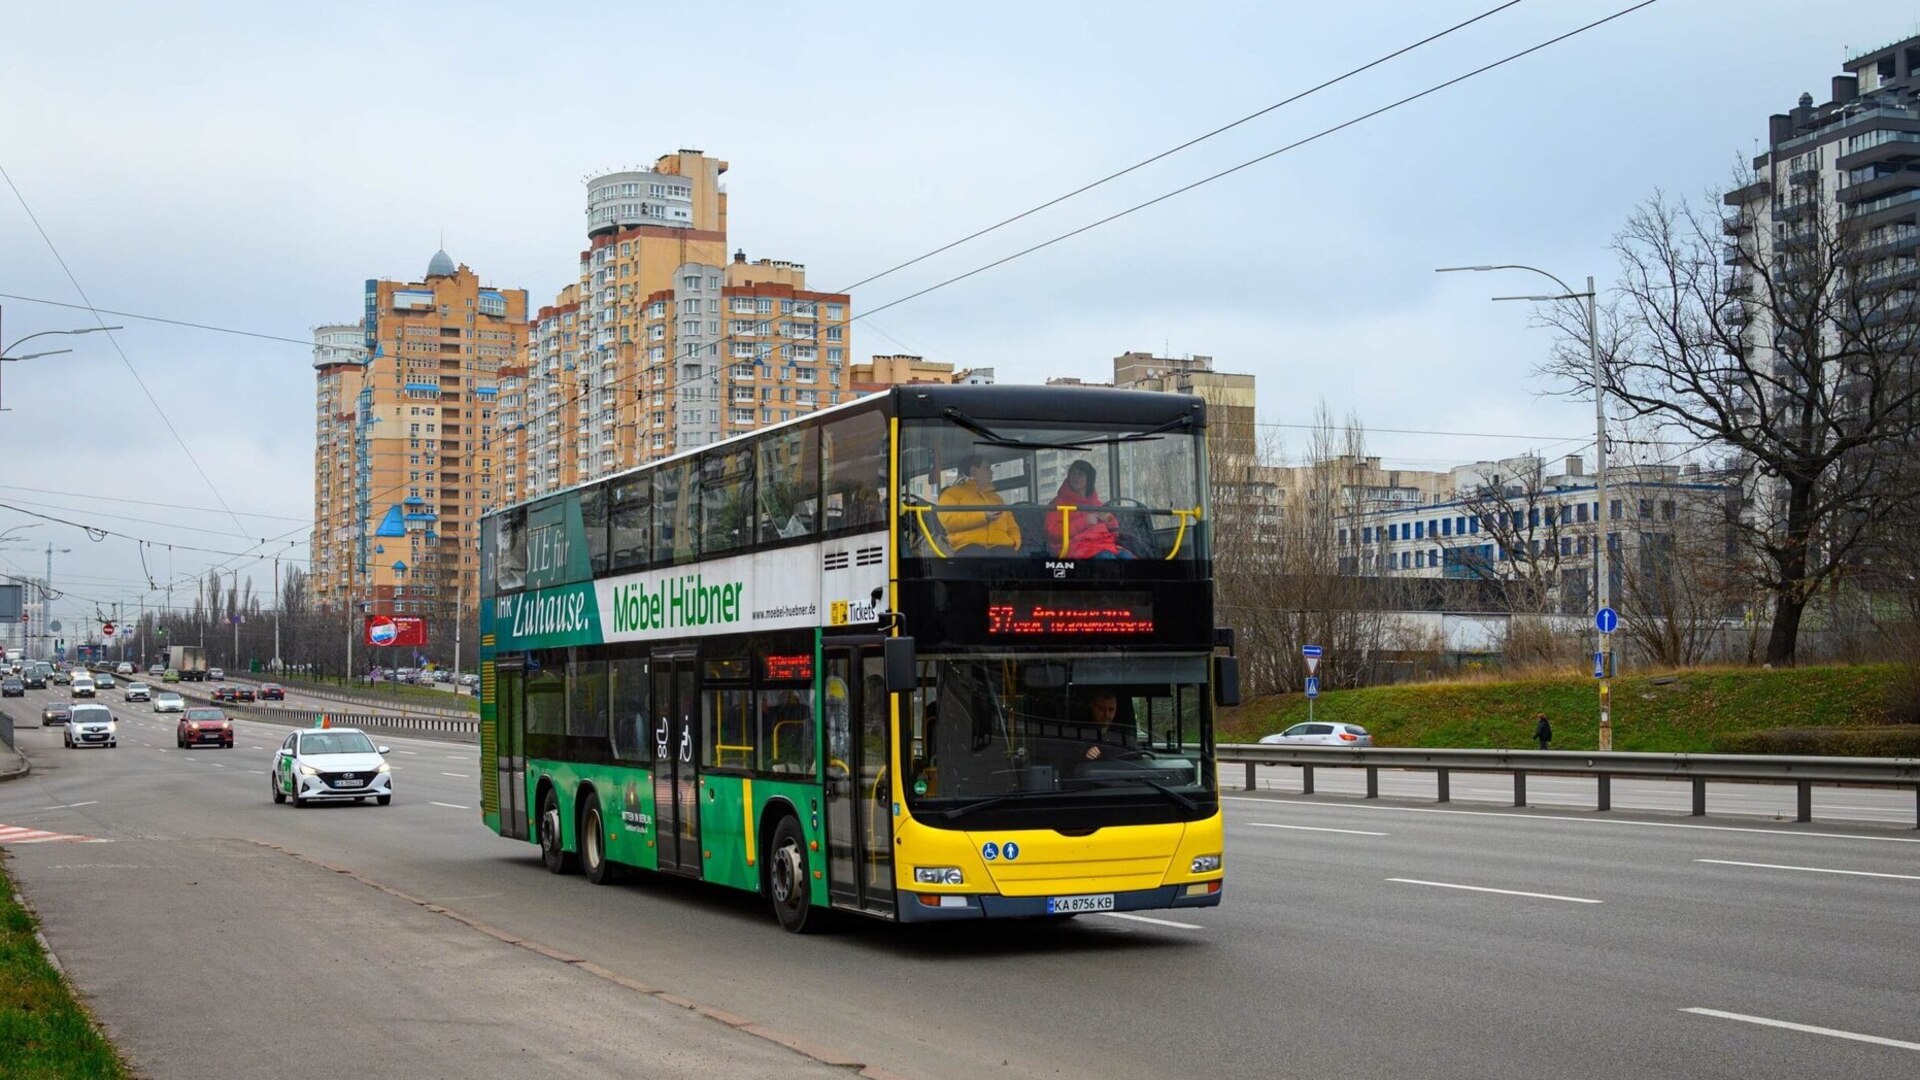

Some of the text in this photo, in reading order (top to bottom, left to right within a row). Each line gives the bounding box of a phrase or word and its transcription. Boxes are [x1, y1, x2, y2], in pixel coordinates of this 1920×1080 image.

[550, 529, 570, 581] für
[1045, 561, 1075, 569] MAN
[512, 578, 589, 637] Zuhause.
[613, 573, 743, 633] Möbel Hübner
[752, 602, 816, 620] www.moebel-huebner.de
[849, 602, 876, 621] Tickets
[1054, 896, 1113, 911] KA 8756 KB
